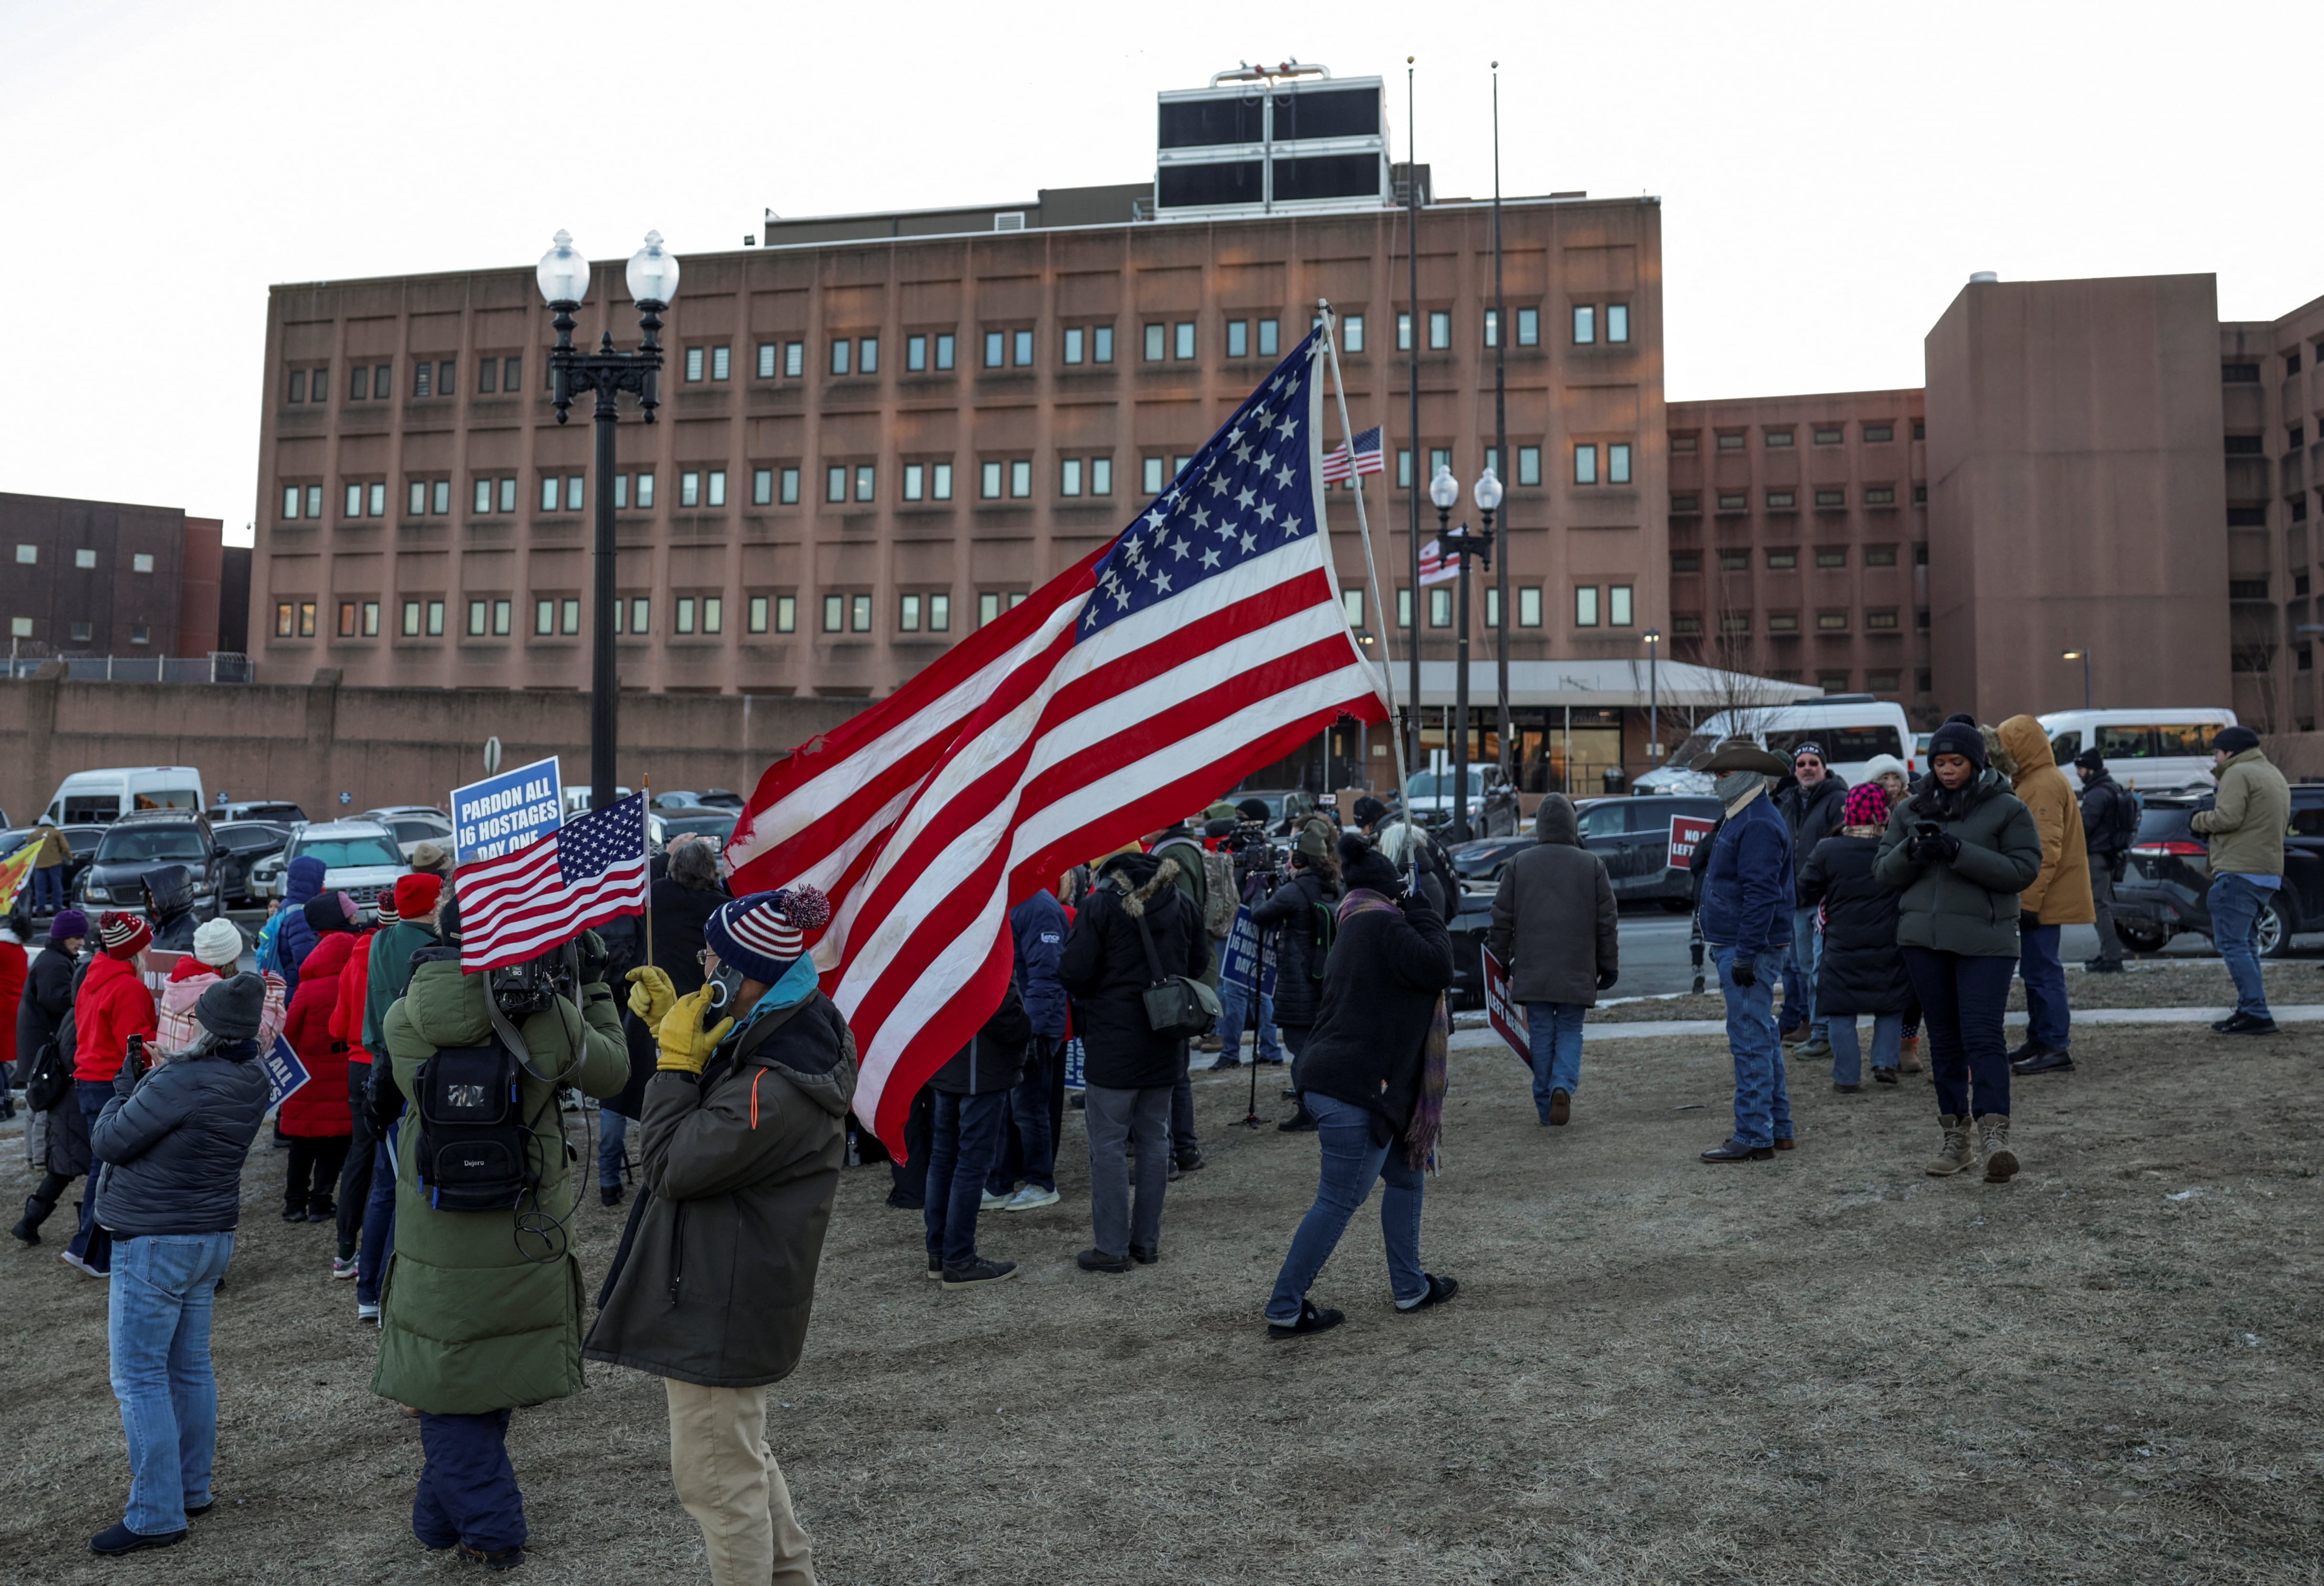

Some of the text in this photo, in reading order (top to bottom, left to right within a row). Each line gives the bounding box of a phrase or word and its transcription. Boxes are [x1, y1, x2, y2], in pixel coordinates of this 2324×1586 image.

[462, 777, 551, 823] PARDON ALL
[459, 799, 558, 848] J6 HOSTAGES
[1684, 829, 1700, 843] NO
[477, 830, 539, 861] DAY ONE
[1672, 842, 1695, 856] LEFT
[1230, 934, 1241, 950] J6
[1235, 956, 1251, 974] DAY
[144, 971, 156, 990] NO
[1494, 975, 1505, 1000] NO
[1489, 990, 1504, 1020] LEFT
[269, 1056, 293, 1087] ALL
